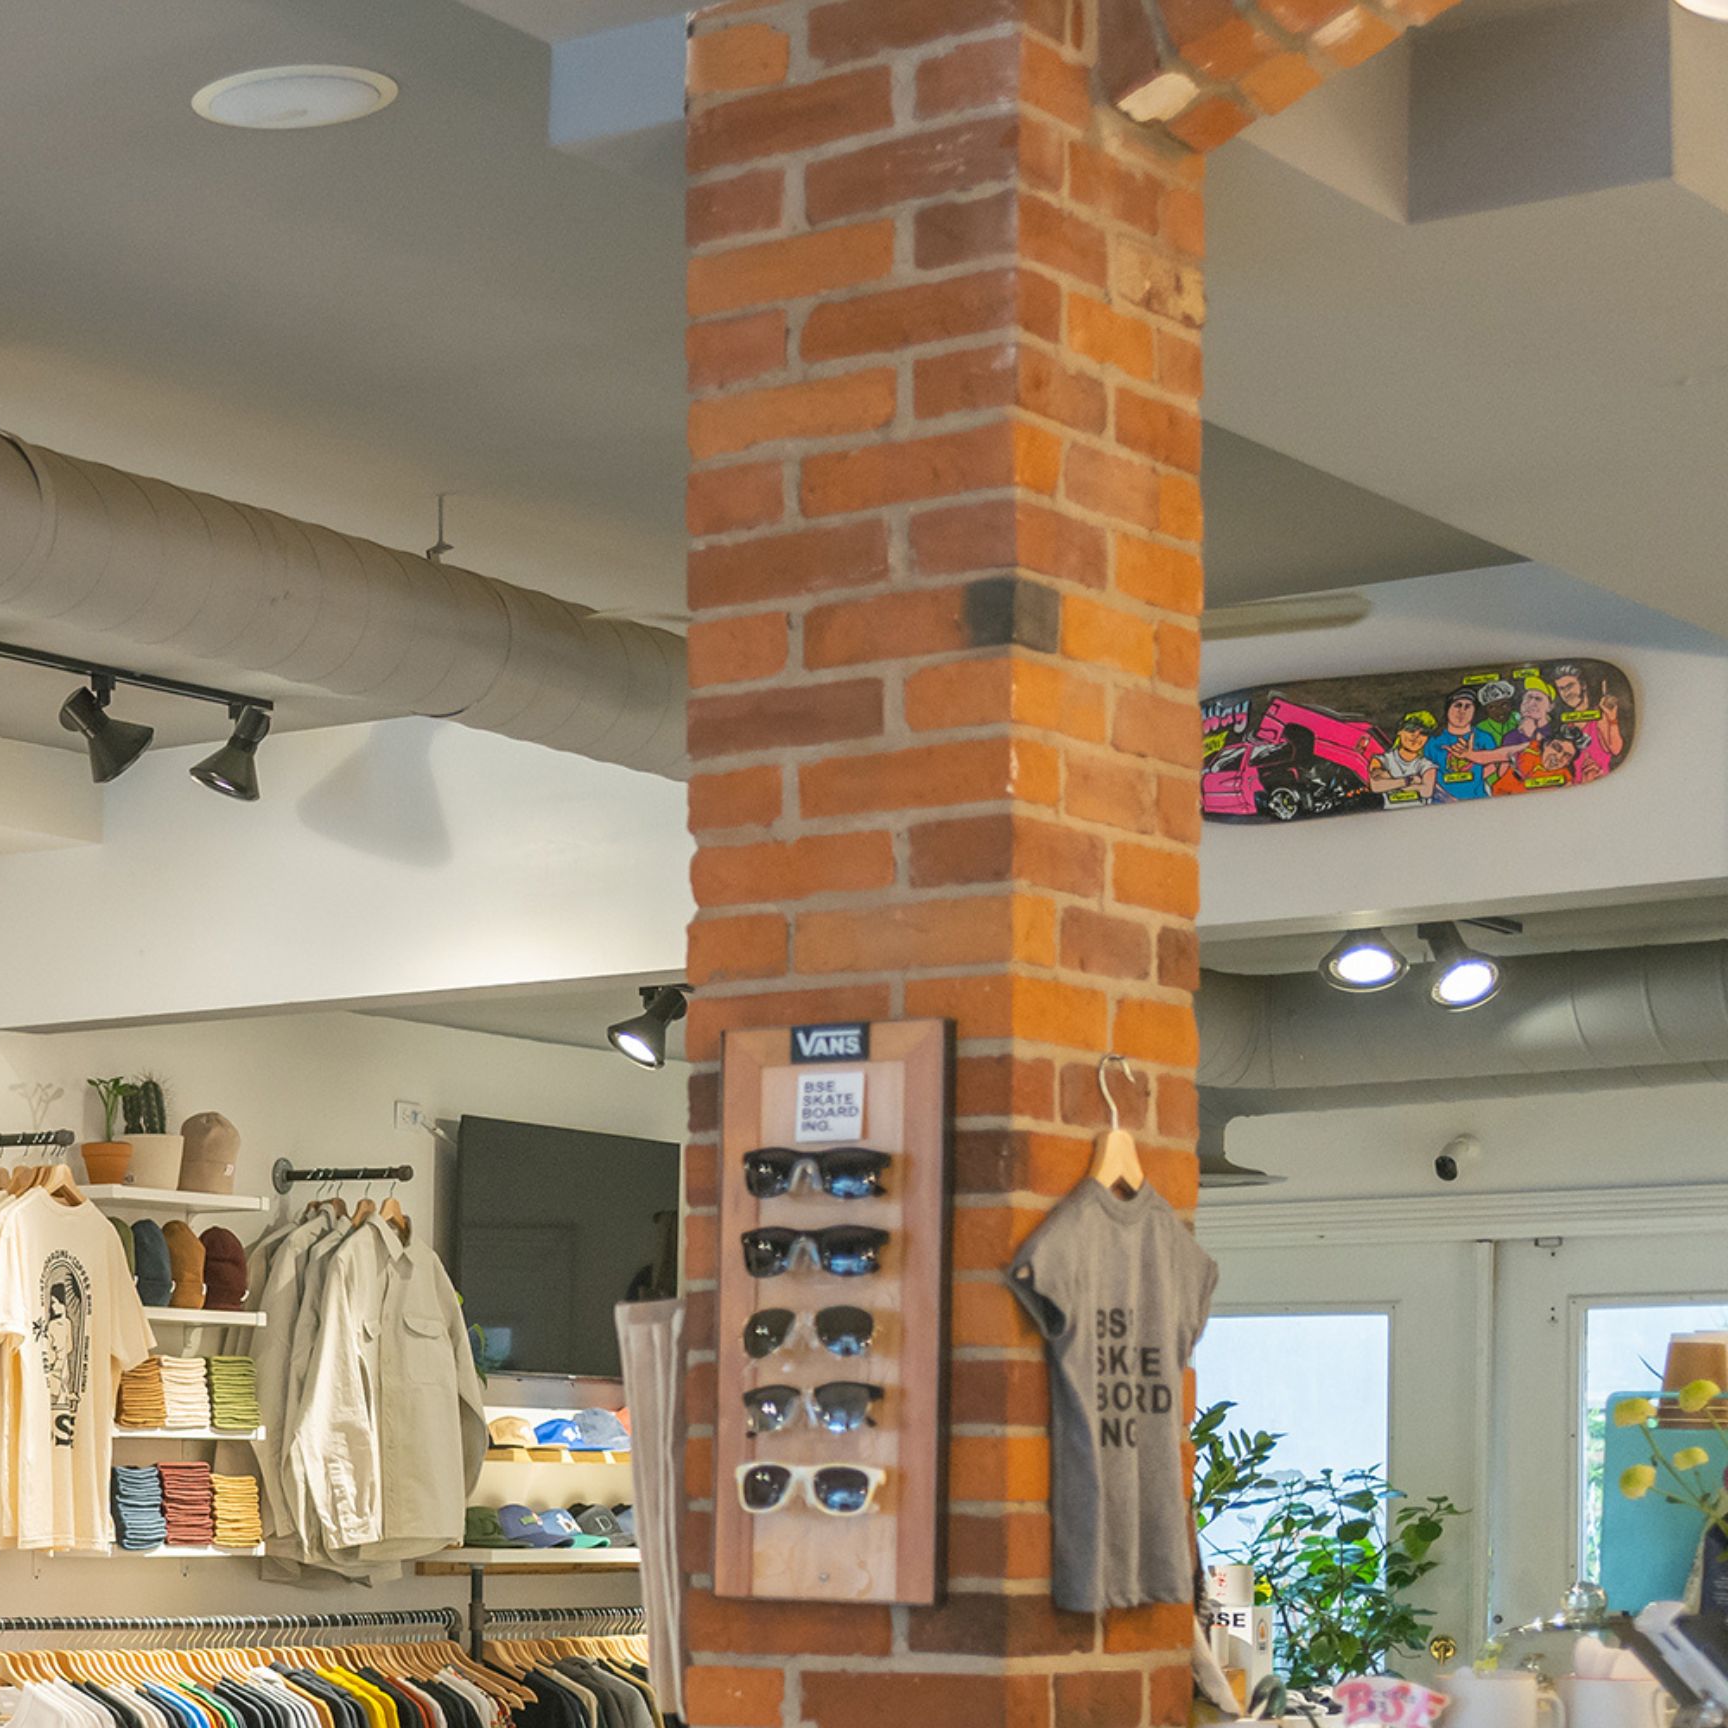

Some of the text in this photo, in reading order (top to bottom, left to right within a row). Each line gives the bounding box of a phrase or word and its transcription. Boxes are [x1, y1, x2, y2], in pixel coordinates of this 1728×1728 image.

[797, 1029, 862, 1057] VANS
[804, 1081, 835, 1093] BSE
[803, 1093, 854, 1106] SKATE
[801, 1106, 860, 1119] BOARD
